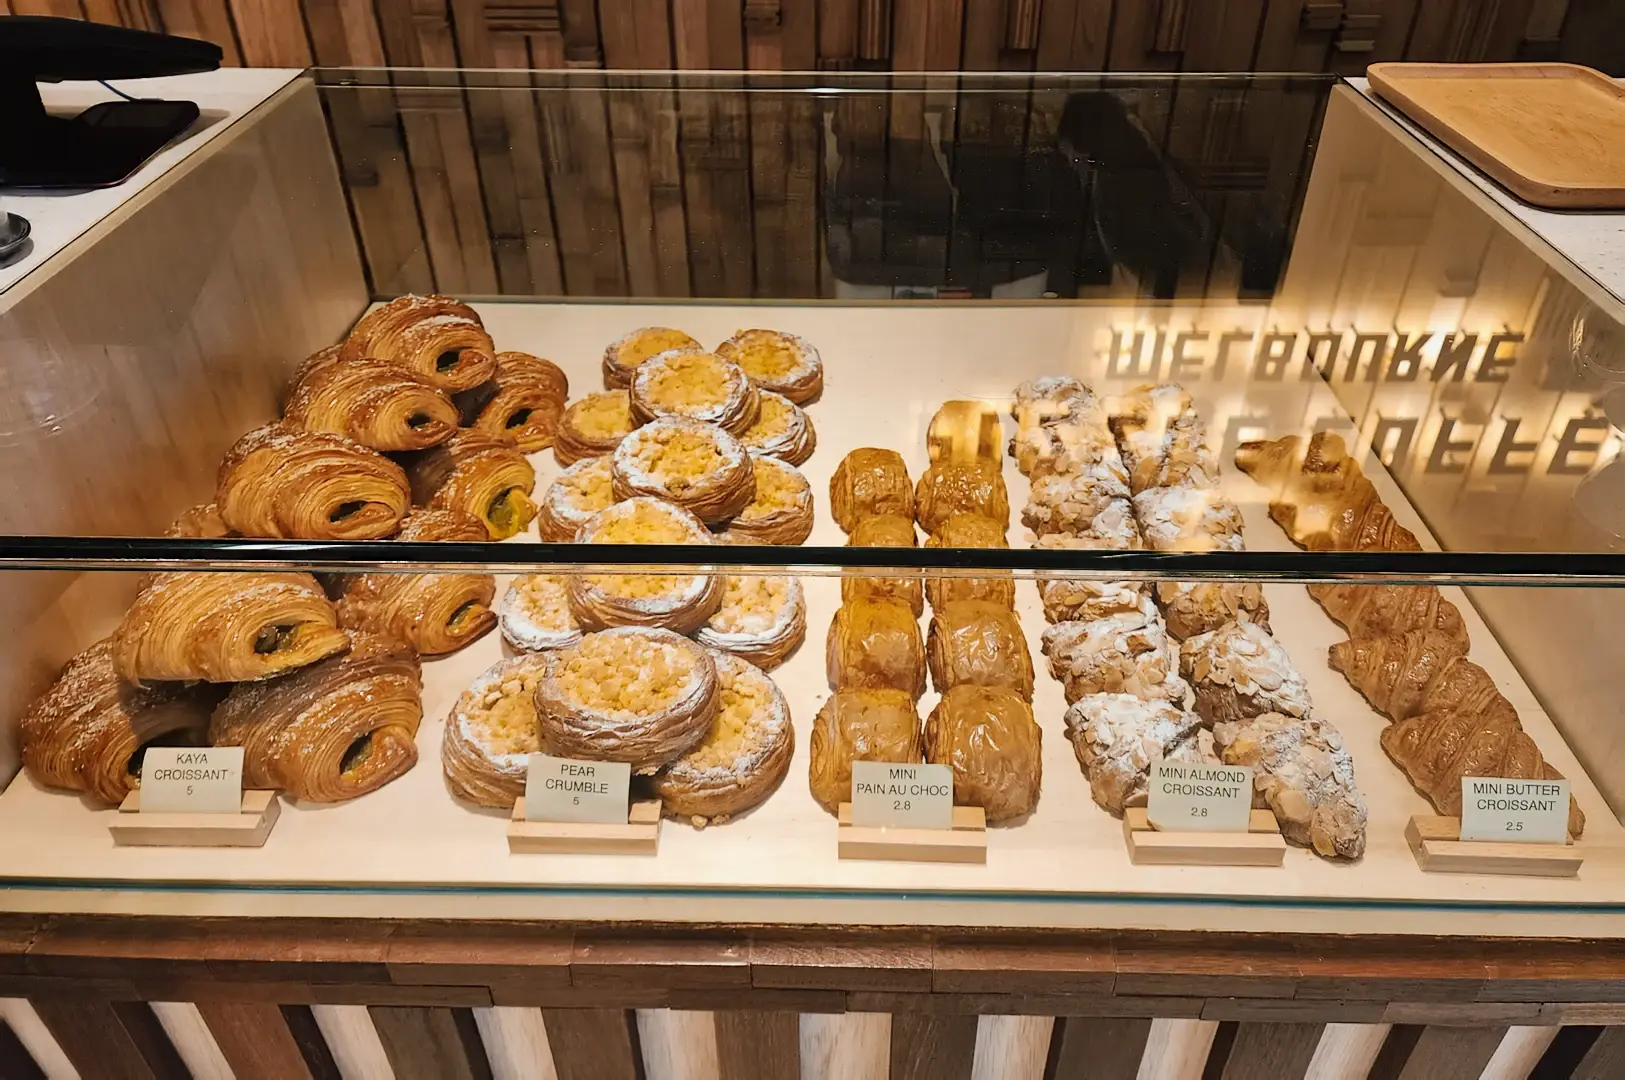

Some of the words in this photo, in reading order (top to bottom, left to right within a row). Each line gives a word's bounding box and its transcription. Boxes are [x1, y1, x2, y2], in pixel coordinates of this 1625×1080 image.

[176, 753, 208, 765] KAYA
[154, 769, 228, 781] CROISSANT
[560, 764, 595, 777] PEAR
[889, 768, 917, 780] MINI
[1159, 766, 1187, 780] MINI
[1189, 768, 1246, 783] ALMOND
[186, 785, 194, 796] 5
[545, 778, 608, 794] CRUMBLE
[856, 783, 886, 795] PAIN
[888, 784, 907, 796] AU
[910, 785, 949, 797] CHOC
[1162, 782, 1241, 799] CROISSANT
[1473, 782, 1502, 795] MINI
[1506, 783, 1561, 796] BUTTER
[572, 796, 580, 806] 5
[893, 800, 911, 811] 2.8
[1477, 799, 1557, 812] CROISSANT
[1190, 807, 1208, 818] 2.8
[1505, 821, 1524, 832] 2.5
